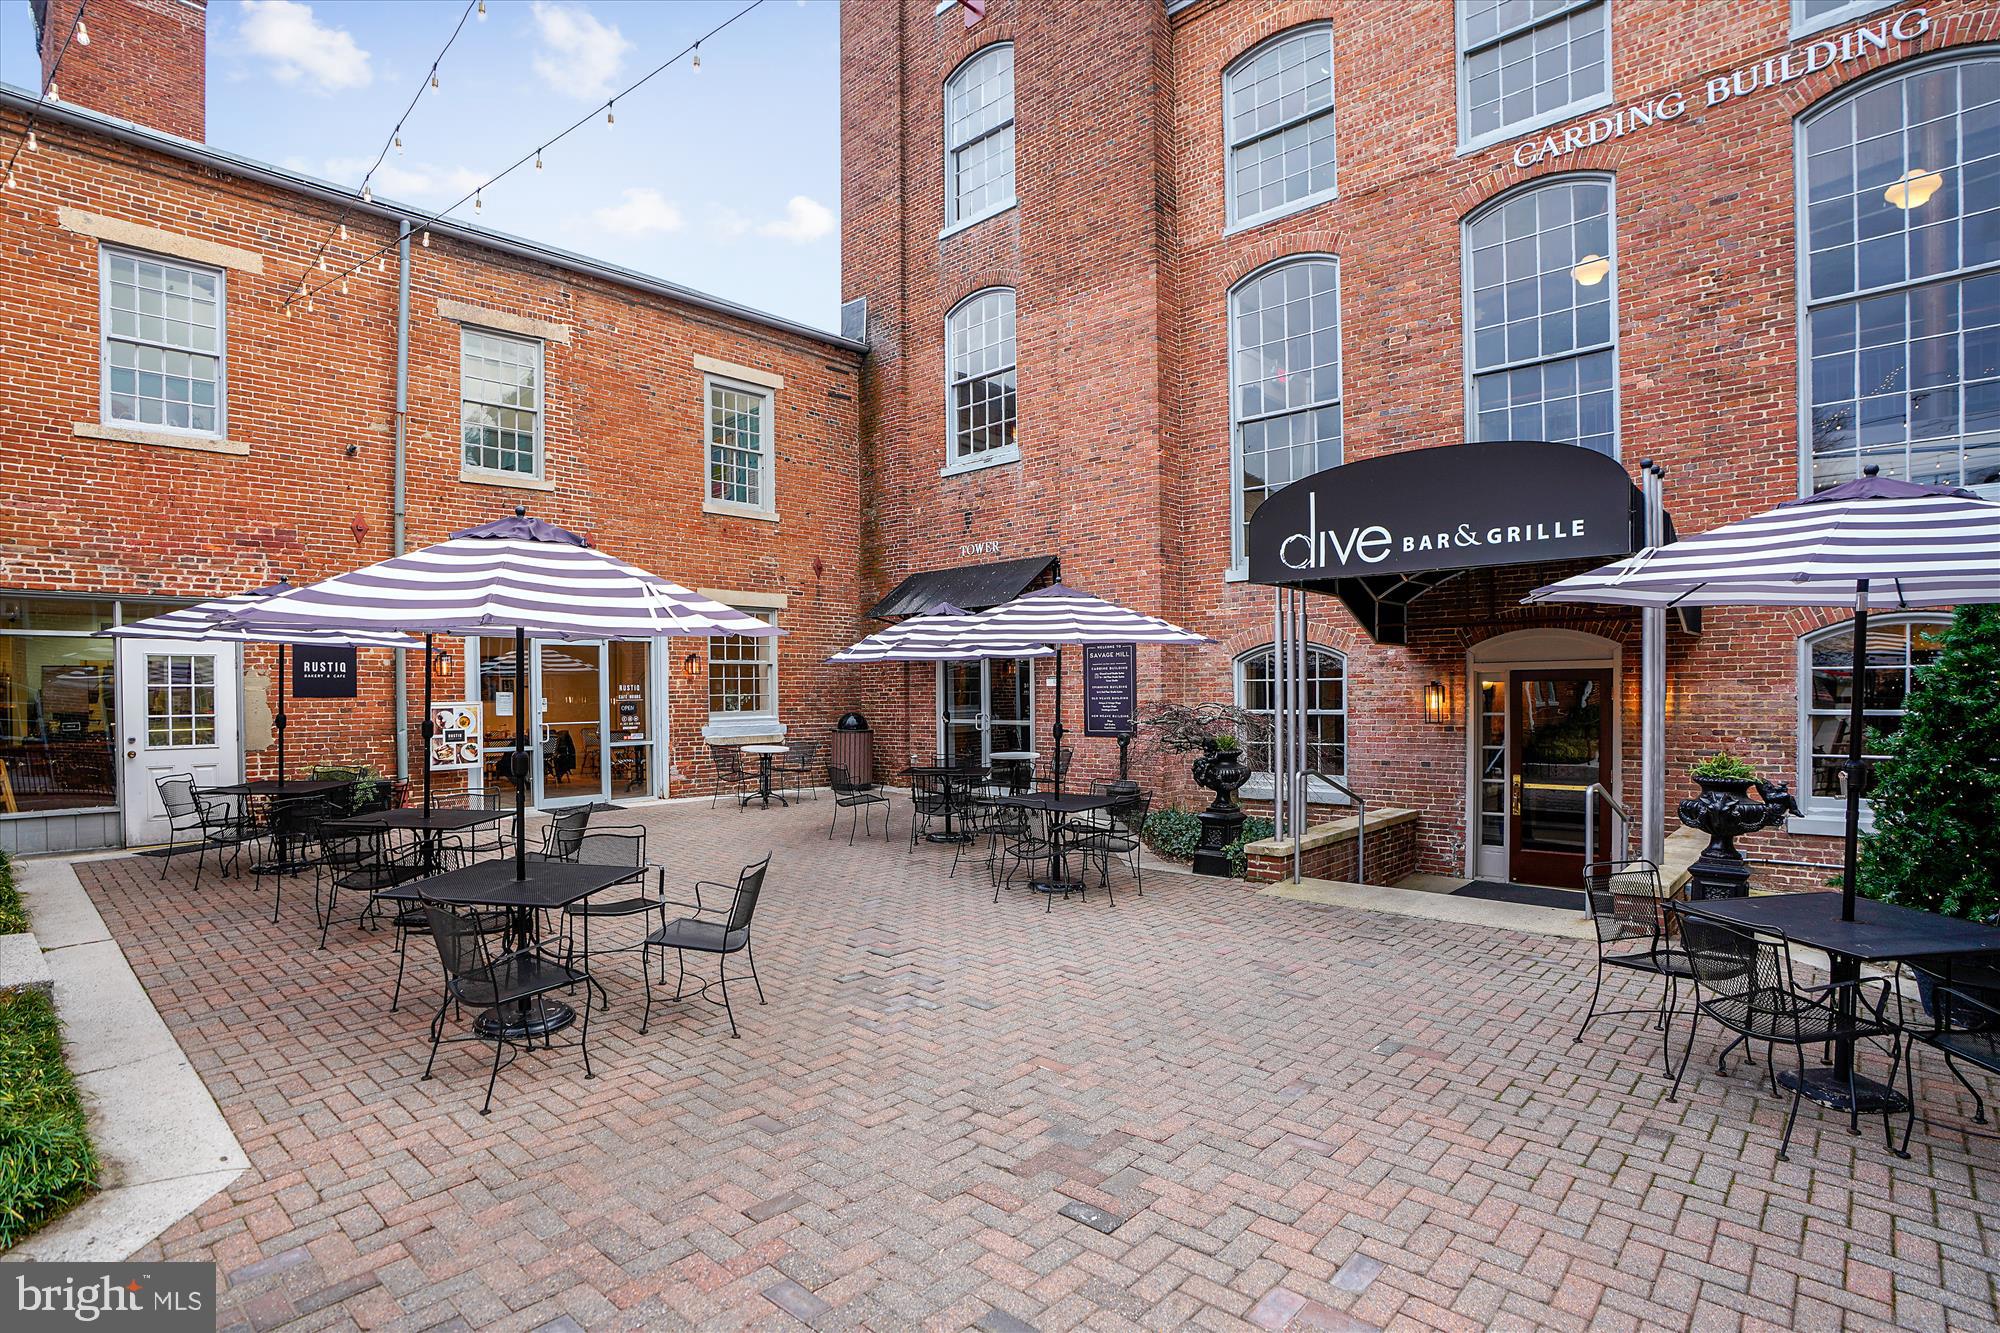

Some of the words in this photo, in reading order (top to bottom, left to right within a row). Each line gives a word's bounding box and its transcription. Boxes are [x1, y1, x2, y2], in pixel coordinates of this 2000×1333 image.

[1513, 92, 1686, 169] CARDING
[1706, 9, 1931, 108] BUILDING
[960, 541, 1000, 557] TOWER
[1280, 492, 1392, 569] dive
[304, 661, 346, 673] RUSTIQ
